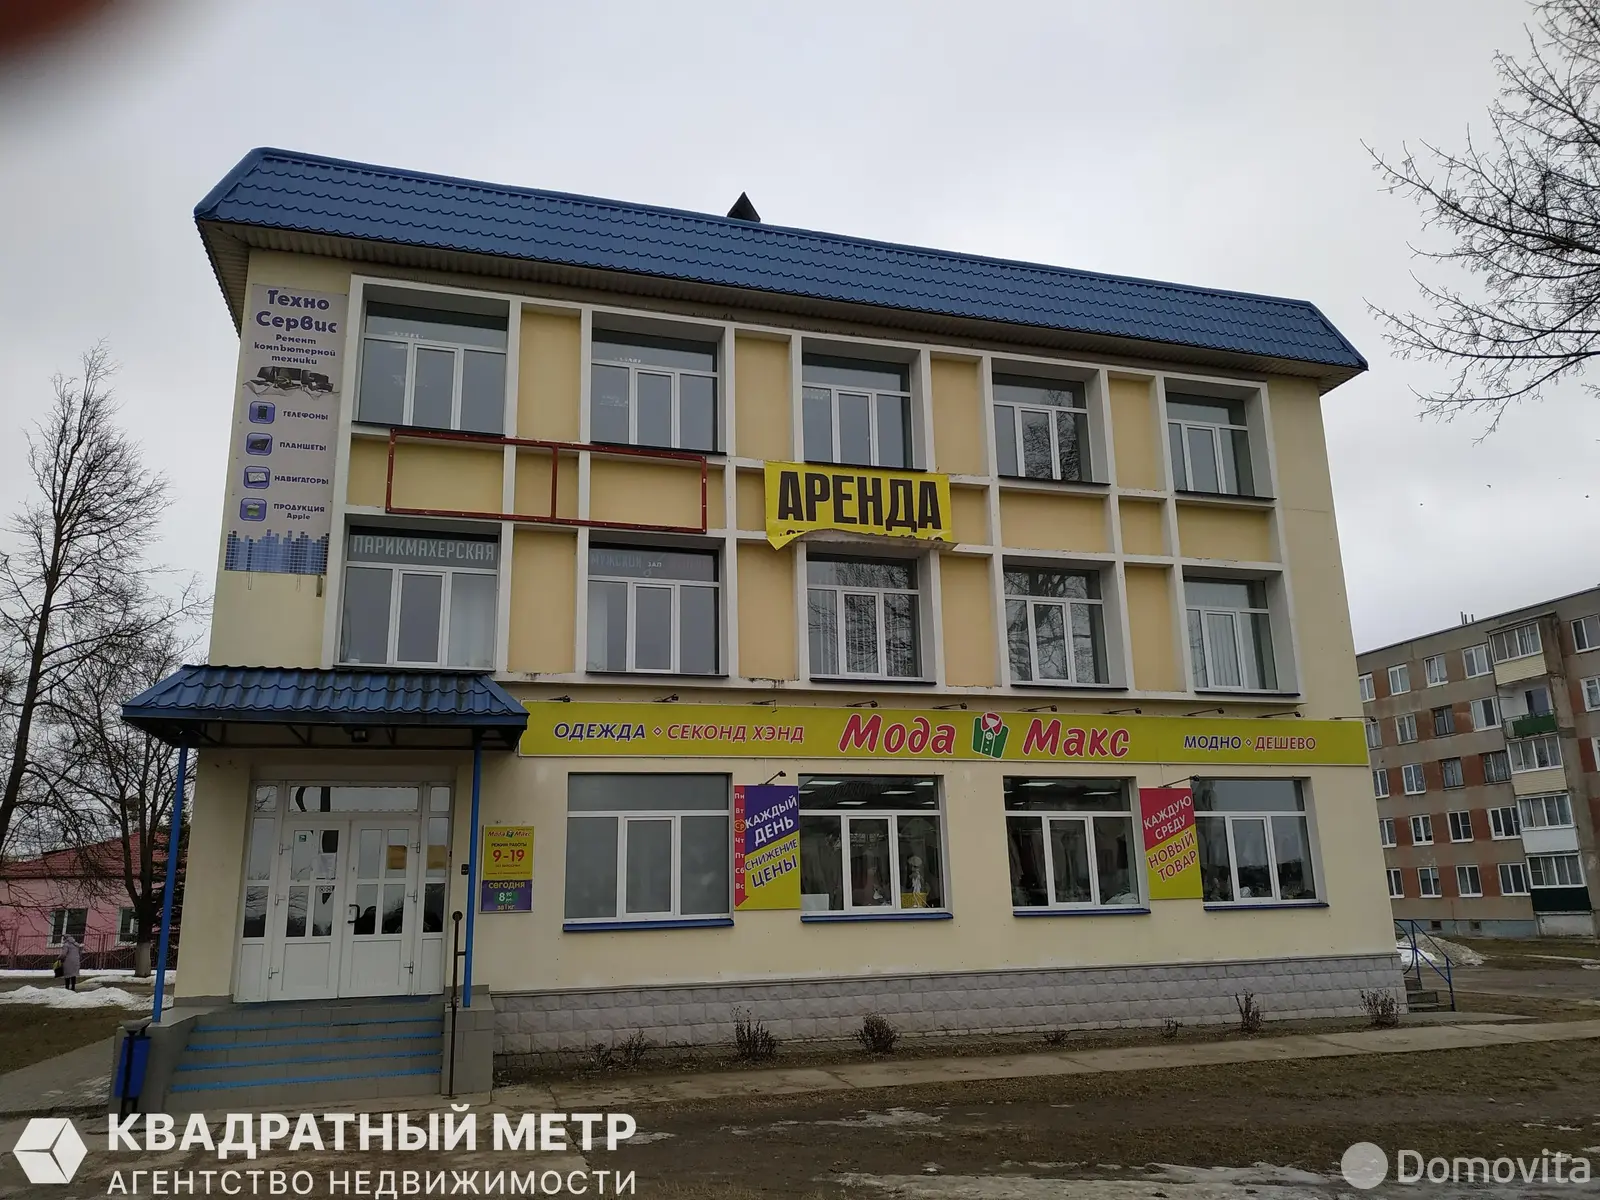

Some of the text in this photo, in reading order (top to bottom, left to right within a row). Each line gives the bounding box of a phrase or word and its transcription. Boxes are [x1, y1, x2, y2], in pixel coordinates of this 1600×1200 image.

[267, 289, 330, 311] Техно
[256, 310, 338, 333] Сервис
[275, 333, 317, 345] Ремонт
[271, 354, 317, 365] техники
[282, 410, 329, 421] ТЕЛЕФОНЫ
[279, 441, 327, 452] ПЛАНШЕТЫ
[274, 475, 329, 485] НАВИГАТОРЫ
[273, 503, 325, 513] ПРОДУКЦИЯ
[777, 470, 942, 533] АРЕНДА
[286, 512, 311, 521] Apple
[353, 534, 495, 561] ПАРИКМАХЕРСКАЯ
[554, 722, 805, 744] ОДЕЖДА СЕКОНД ХЭНД
[838, 713, 1131, 758] Мода Макс
[1184, 735, 1317, 752] МОДНО ДЕШЕВО
[745, 795, 798, 829] КАЖДЫЙ
[1143, 796, 1191, 829] КАЖДУЮ
[755, 816, 794, 847] ДЕНЬ
[1155, 814, 1186, 840] СРЕДУ
[745, 838, 798, 871] СНИЖЕНИЕ
[1148, 831, 1195, 869] НОВЫЙ
[751, 854, 797, 888] ЦЕНЫ
[1157, 850, 1197, 882] ТОВАР
[735, 882, 744, 890] Вс
